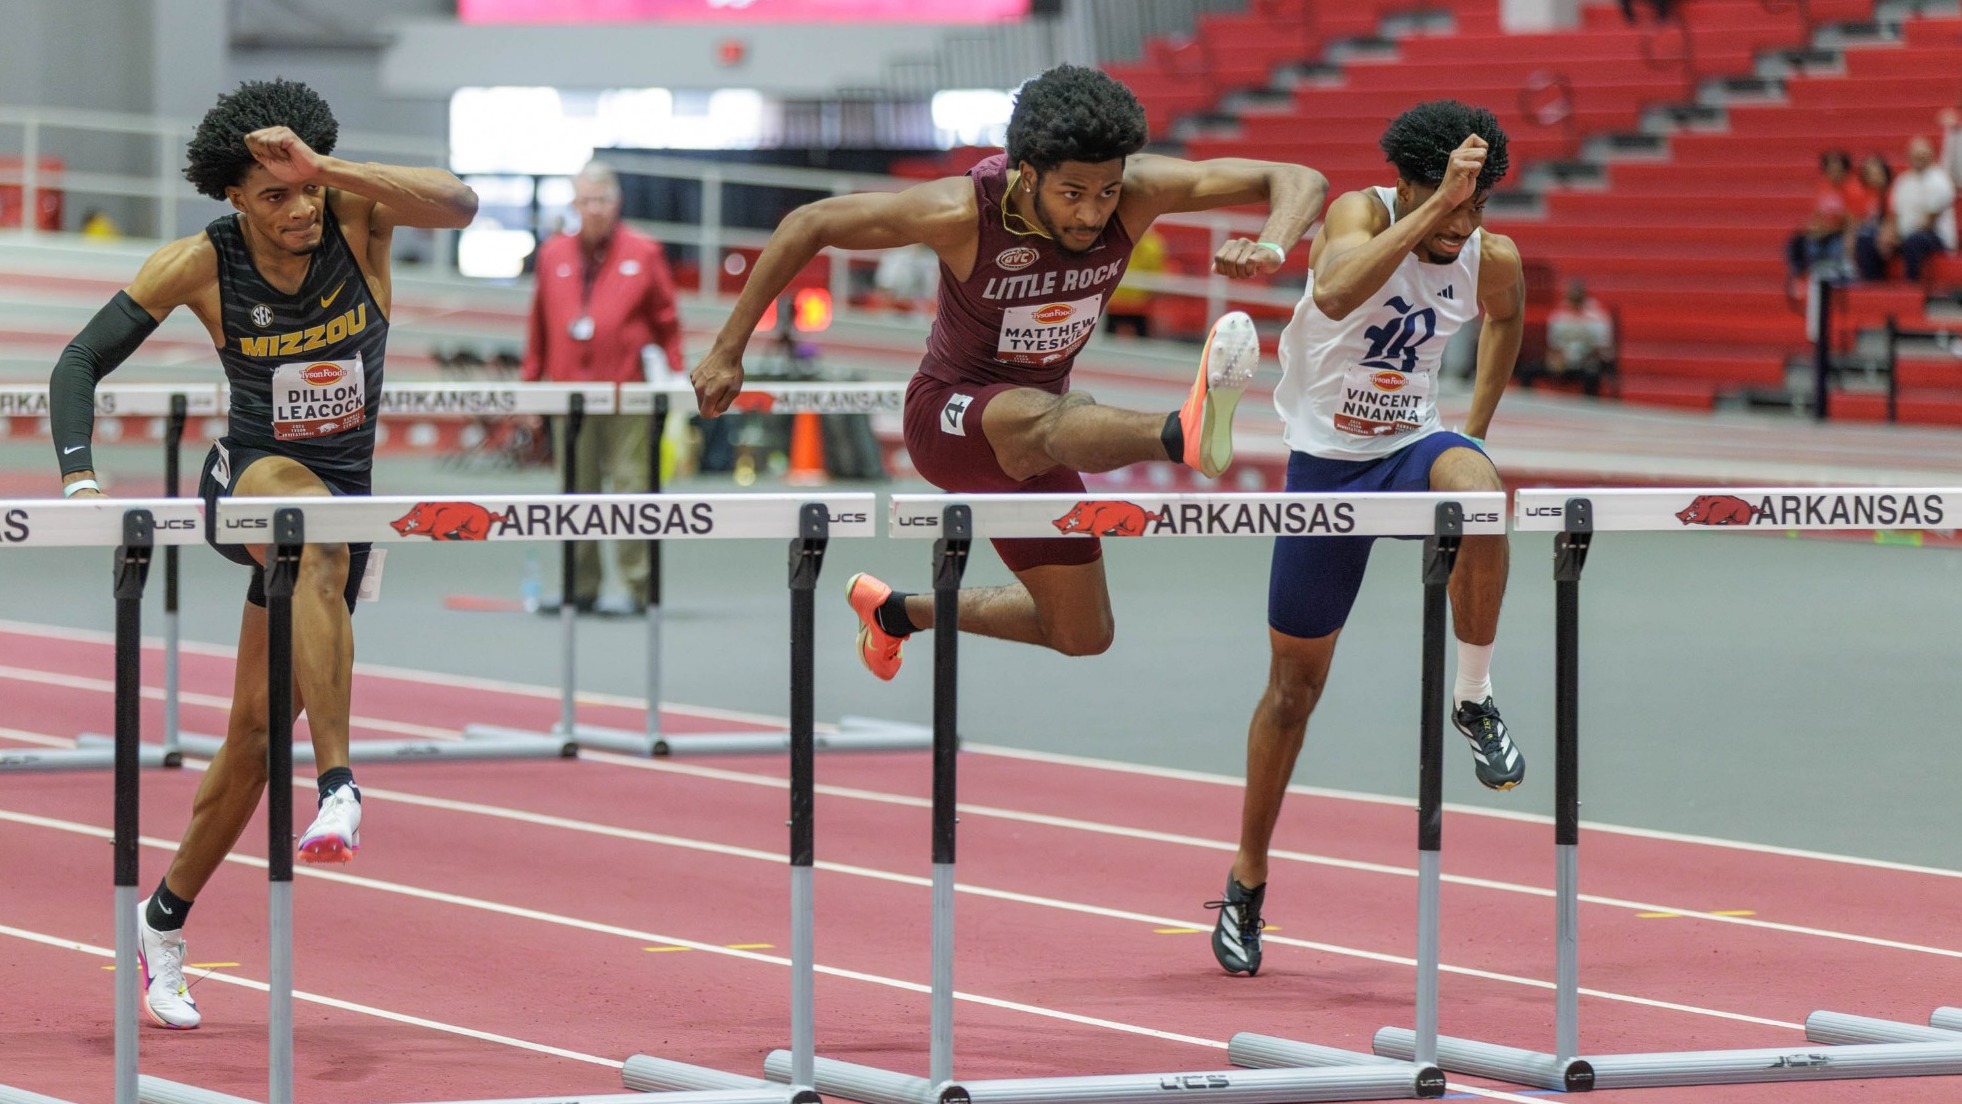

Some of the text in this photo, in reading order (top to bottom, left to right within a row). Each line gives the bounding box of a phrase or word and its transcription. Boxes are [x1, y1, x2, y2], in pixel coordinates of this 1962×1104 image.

[982, 258, 1122, 300] LITTLE ROCK
[253, 305, 272, 326] SEC
[239, 303, 366, 357] MIZZOU
[1005, 316, 1095, 338] MATTHEW
[1010, 331, 1083, 350] TYESKIE
[288, 383, 357, 404] DILLON
[380, 391, 516, 412] ARKANSAS
[775, 390, 900, 410] ARKANSAS
[1347, 387, 1422, 408] VINCENT
[278, 393, 363, 420] LEACOCK
[945, 401, 965, 428] 4
[1342, 401, 1418, 423] NNANNA
[498, 502, 714, 536] ARKANSAS
[828, 513, 868, 523] UCS
[1152, 502, 1355, 534] ARKANSAS
[1462, 512, 1499, 523] UCS
[1526, 507, 1563, 517] UCS
[1755, 494, 1944, 526] ARKANSAS
[153, 519, 196, 530] UCS
[226, 518, 268, 529] UCS
[899, 516, 939, 527] UCS
[1160, 1074, 1230, 1090] UCS
